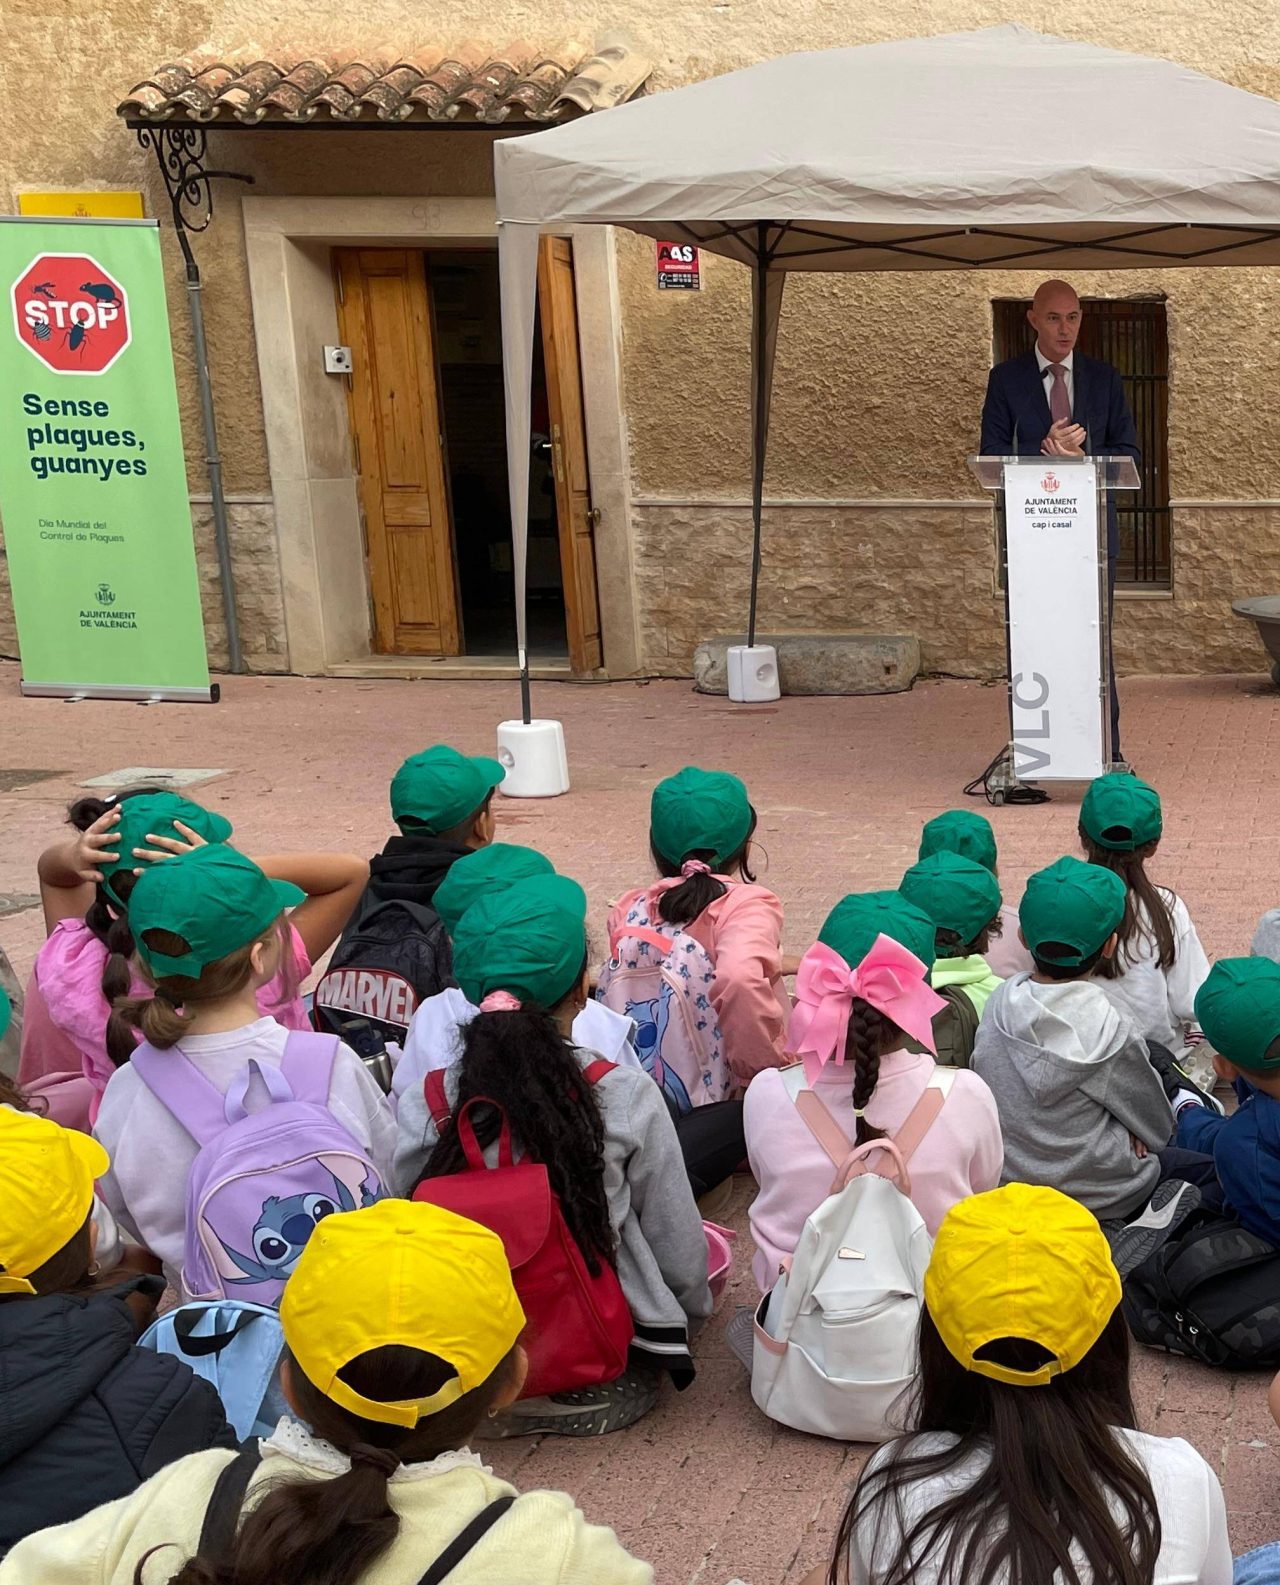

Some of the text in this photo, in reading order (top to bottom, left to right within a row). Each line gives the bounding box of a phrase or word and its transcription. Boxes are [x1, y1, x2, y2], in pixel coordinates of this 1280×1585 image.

[24, 300, 119, 329] STOP
[23, 393, 109, 417] Sense
[27, 423, 145, 452] plagues,
[31, 456, 147, 481] guanyes
[56, 519, 91, 529] Mundial
[93, 521, 107, 529] del
[1032, 522, 1047, 530] cap
[1052, 520, 1072, 528] casal
[39, 531, 125, 544] Control de Plagues
[79, 610, 136, 619] AJUNTAMENT
[1012, 672, 1051, 776] VLC
[317, 971, 415, 1024] MARVEL
